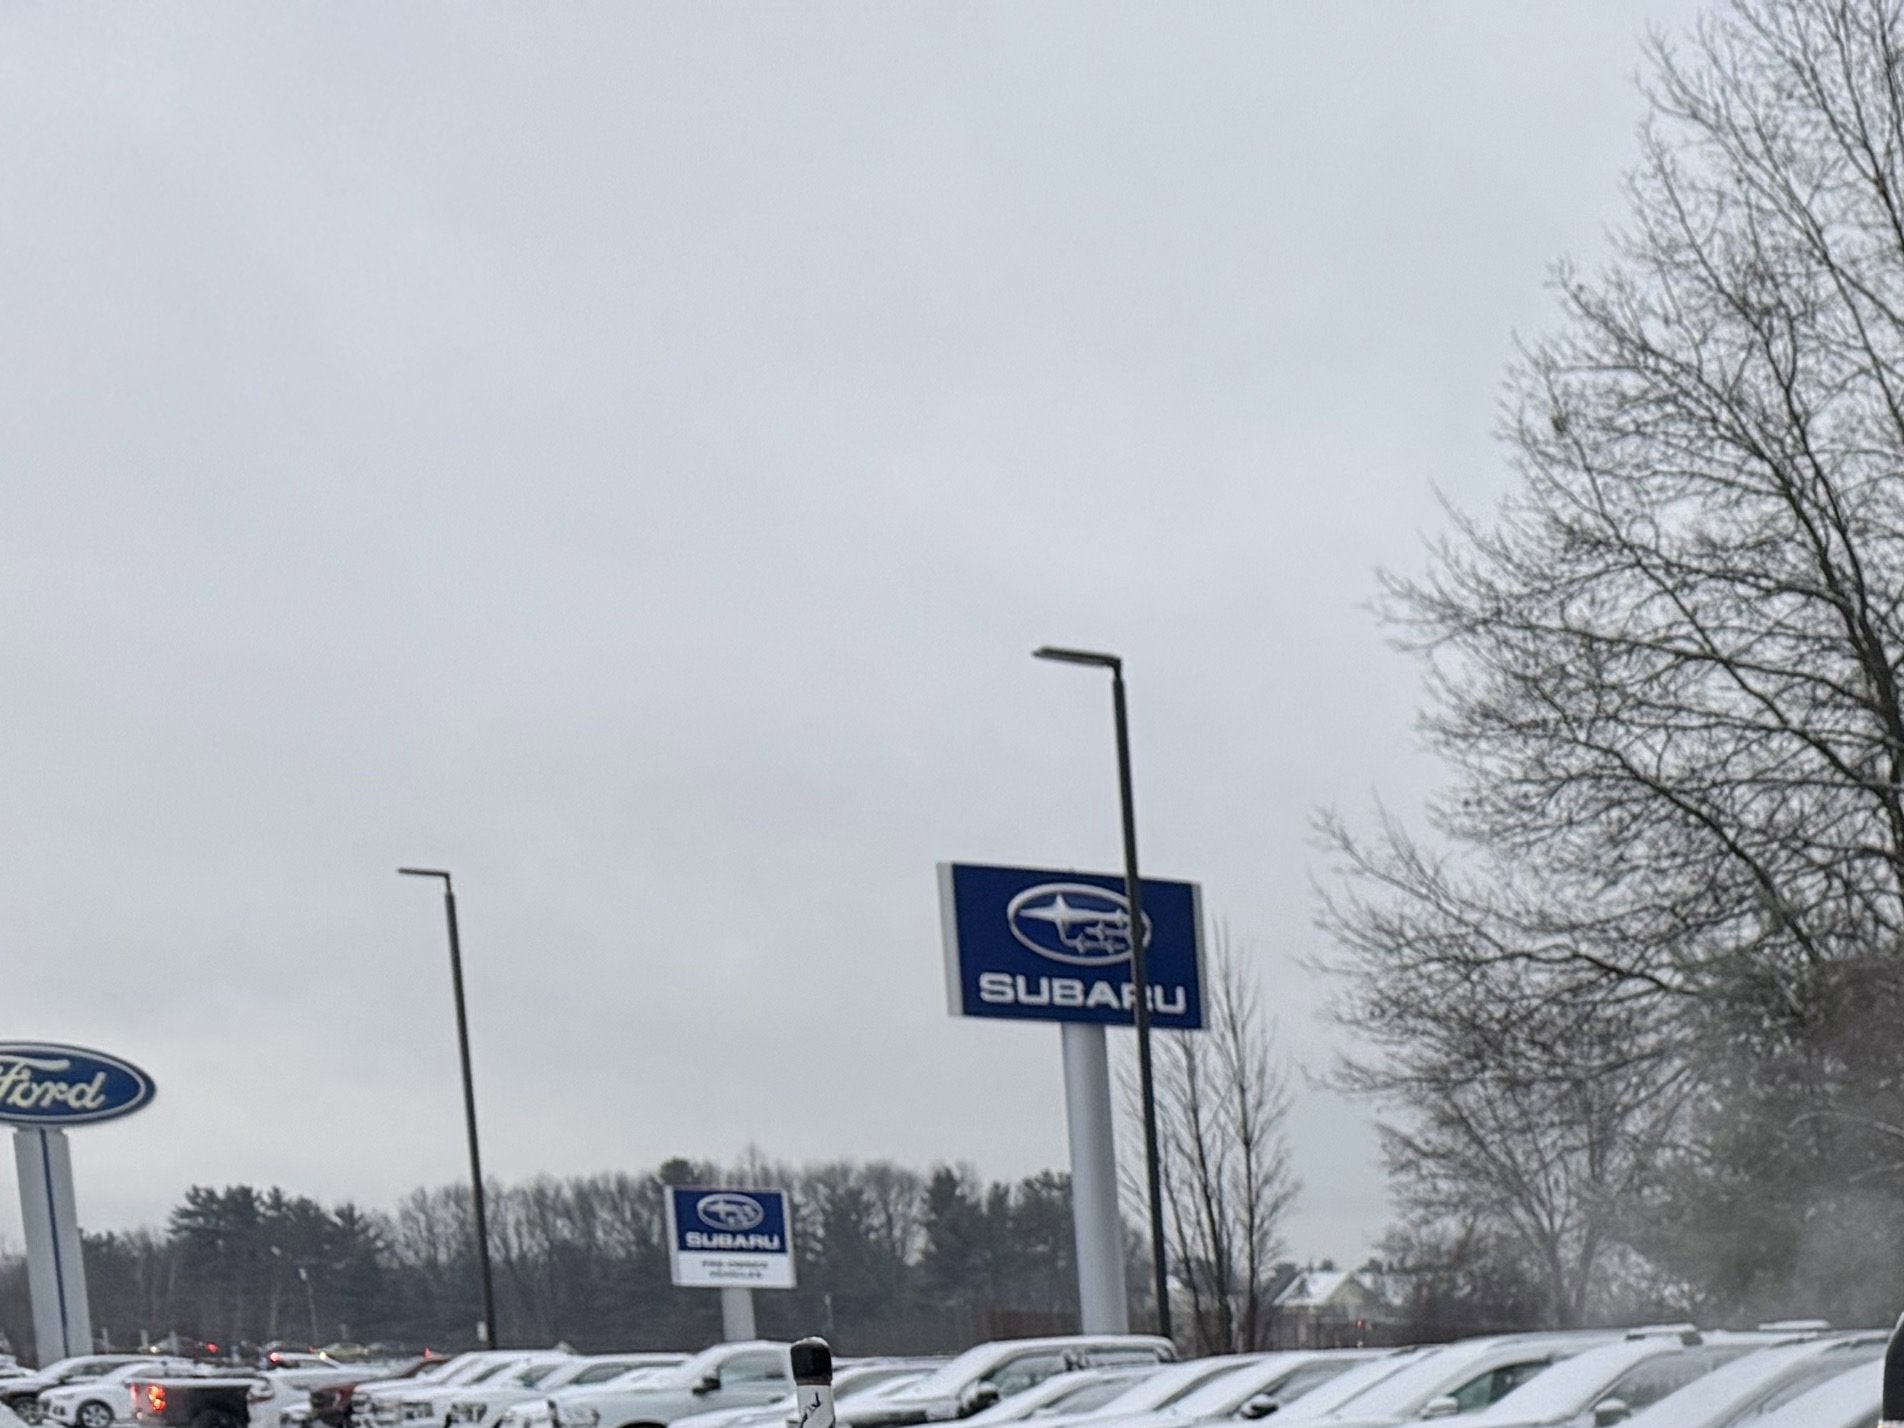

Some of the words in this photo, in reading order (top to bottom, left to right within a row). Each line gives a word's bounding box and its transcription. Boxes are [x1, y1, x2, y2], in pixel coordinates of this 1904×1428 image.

[978, 971, 1187, 1015] SUBARU
[0, 1054, 108, 1110] Ford
[685, 1231, 780, 1250] SUBARU
